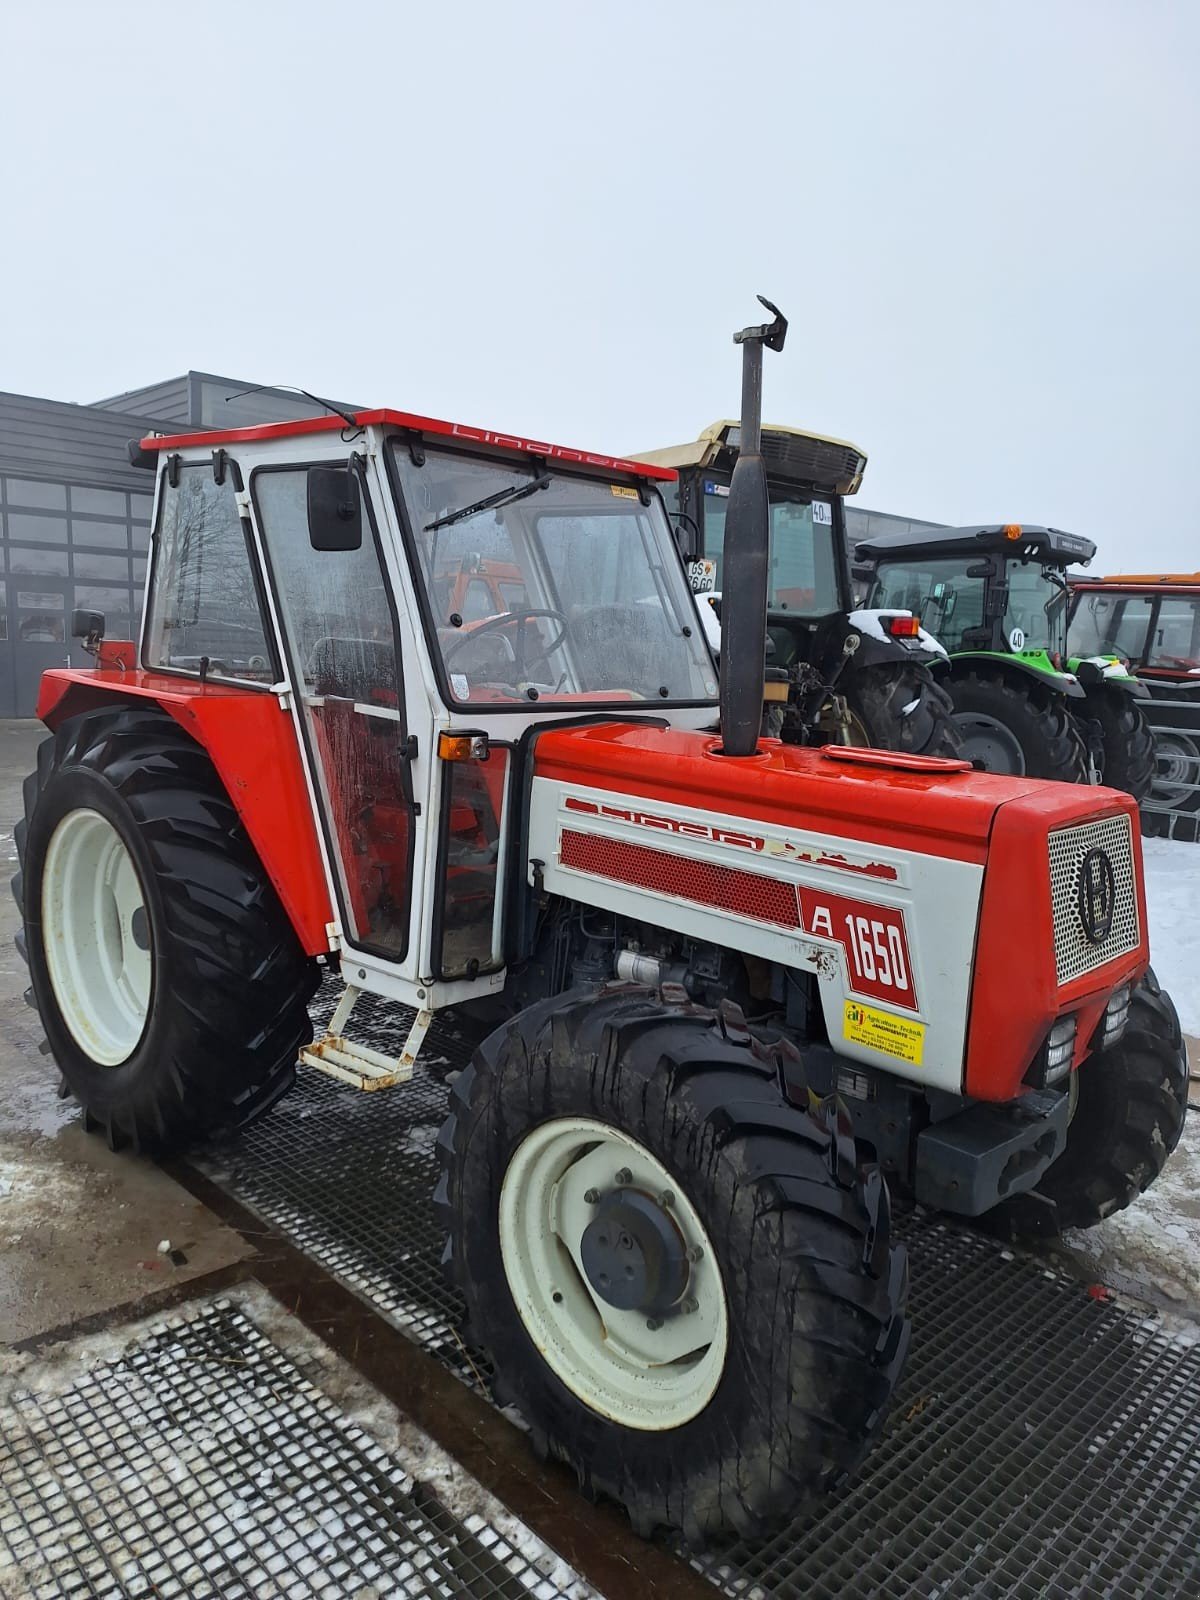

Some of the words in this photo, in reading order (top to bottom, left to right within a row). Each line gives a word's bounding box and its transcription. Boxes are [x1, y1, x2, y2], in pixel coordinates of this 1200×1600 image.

[452, 424, 636, 469] Lindner
[813, 503, 824, 521] 40
[692, 562, 704, 576] GS
[1012, 632, 1022, 648] 40
[811, 905, 833, 937] A
[845, 913, 908, 991] 1650
